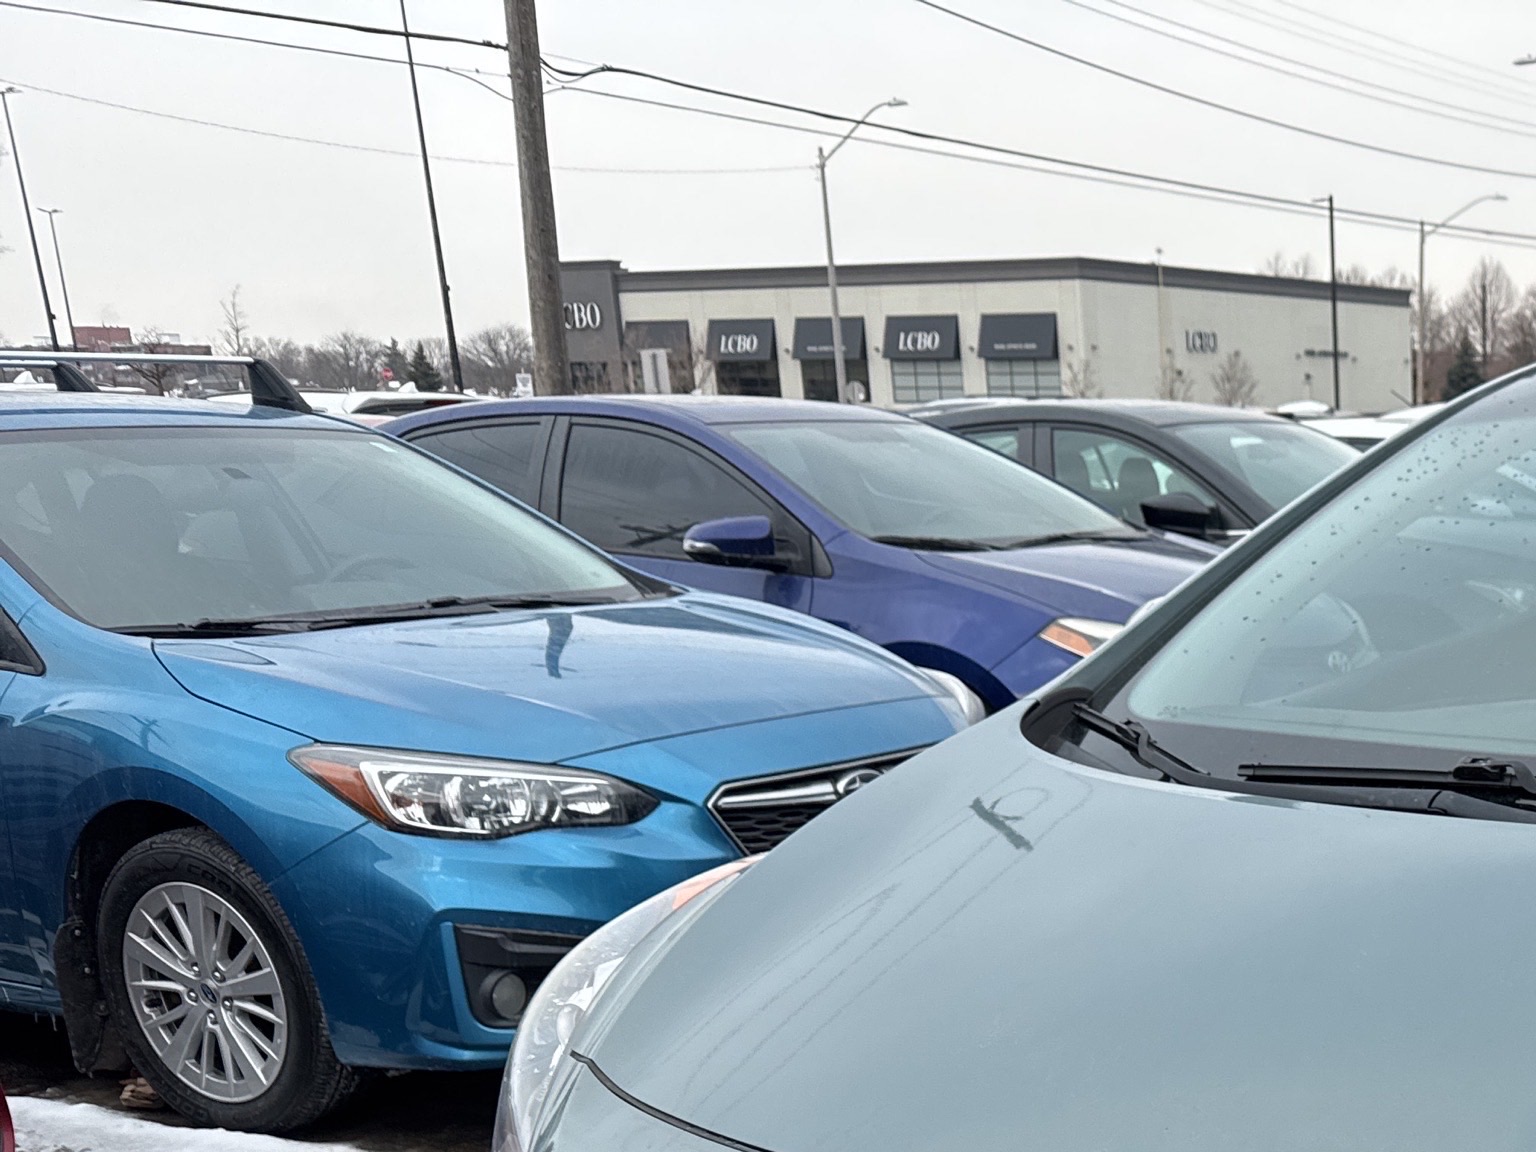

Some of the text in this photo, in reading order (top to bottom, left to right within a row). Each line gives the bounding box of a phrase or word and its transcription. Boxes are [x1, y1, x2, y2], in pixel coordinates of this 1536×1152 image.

[562, 302, 600, 330] CBO
[720, 334, 758, 354] LCBO
[898, 331, 940, 352] LCBO
[1185, 330, 1218, 354] LCBO
